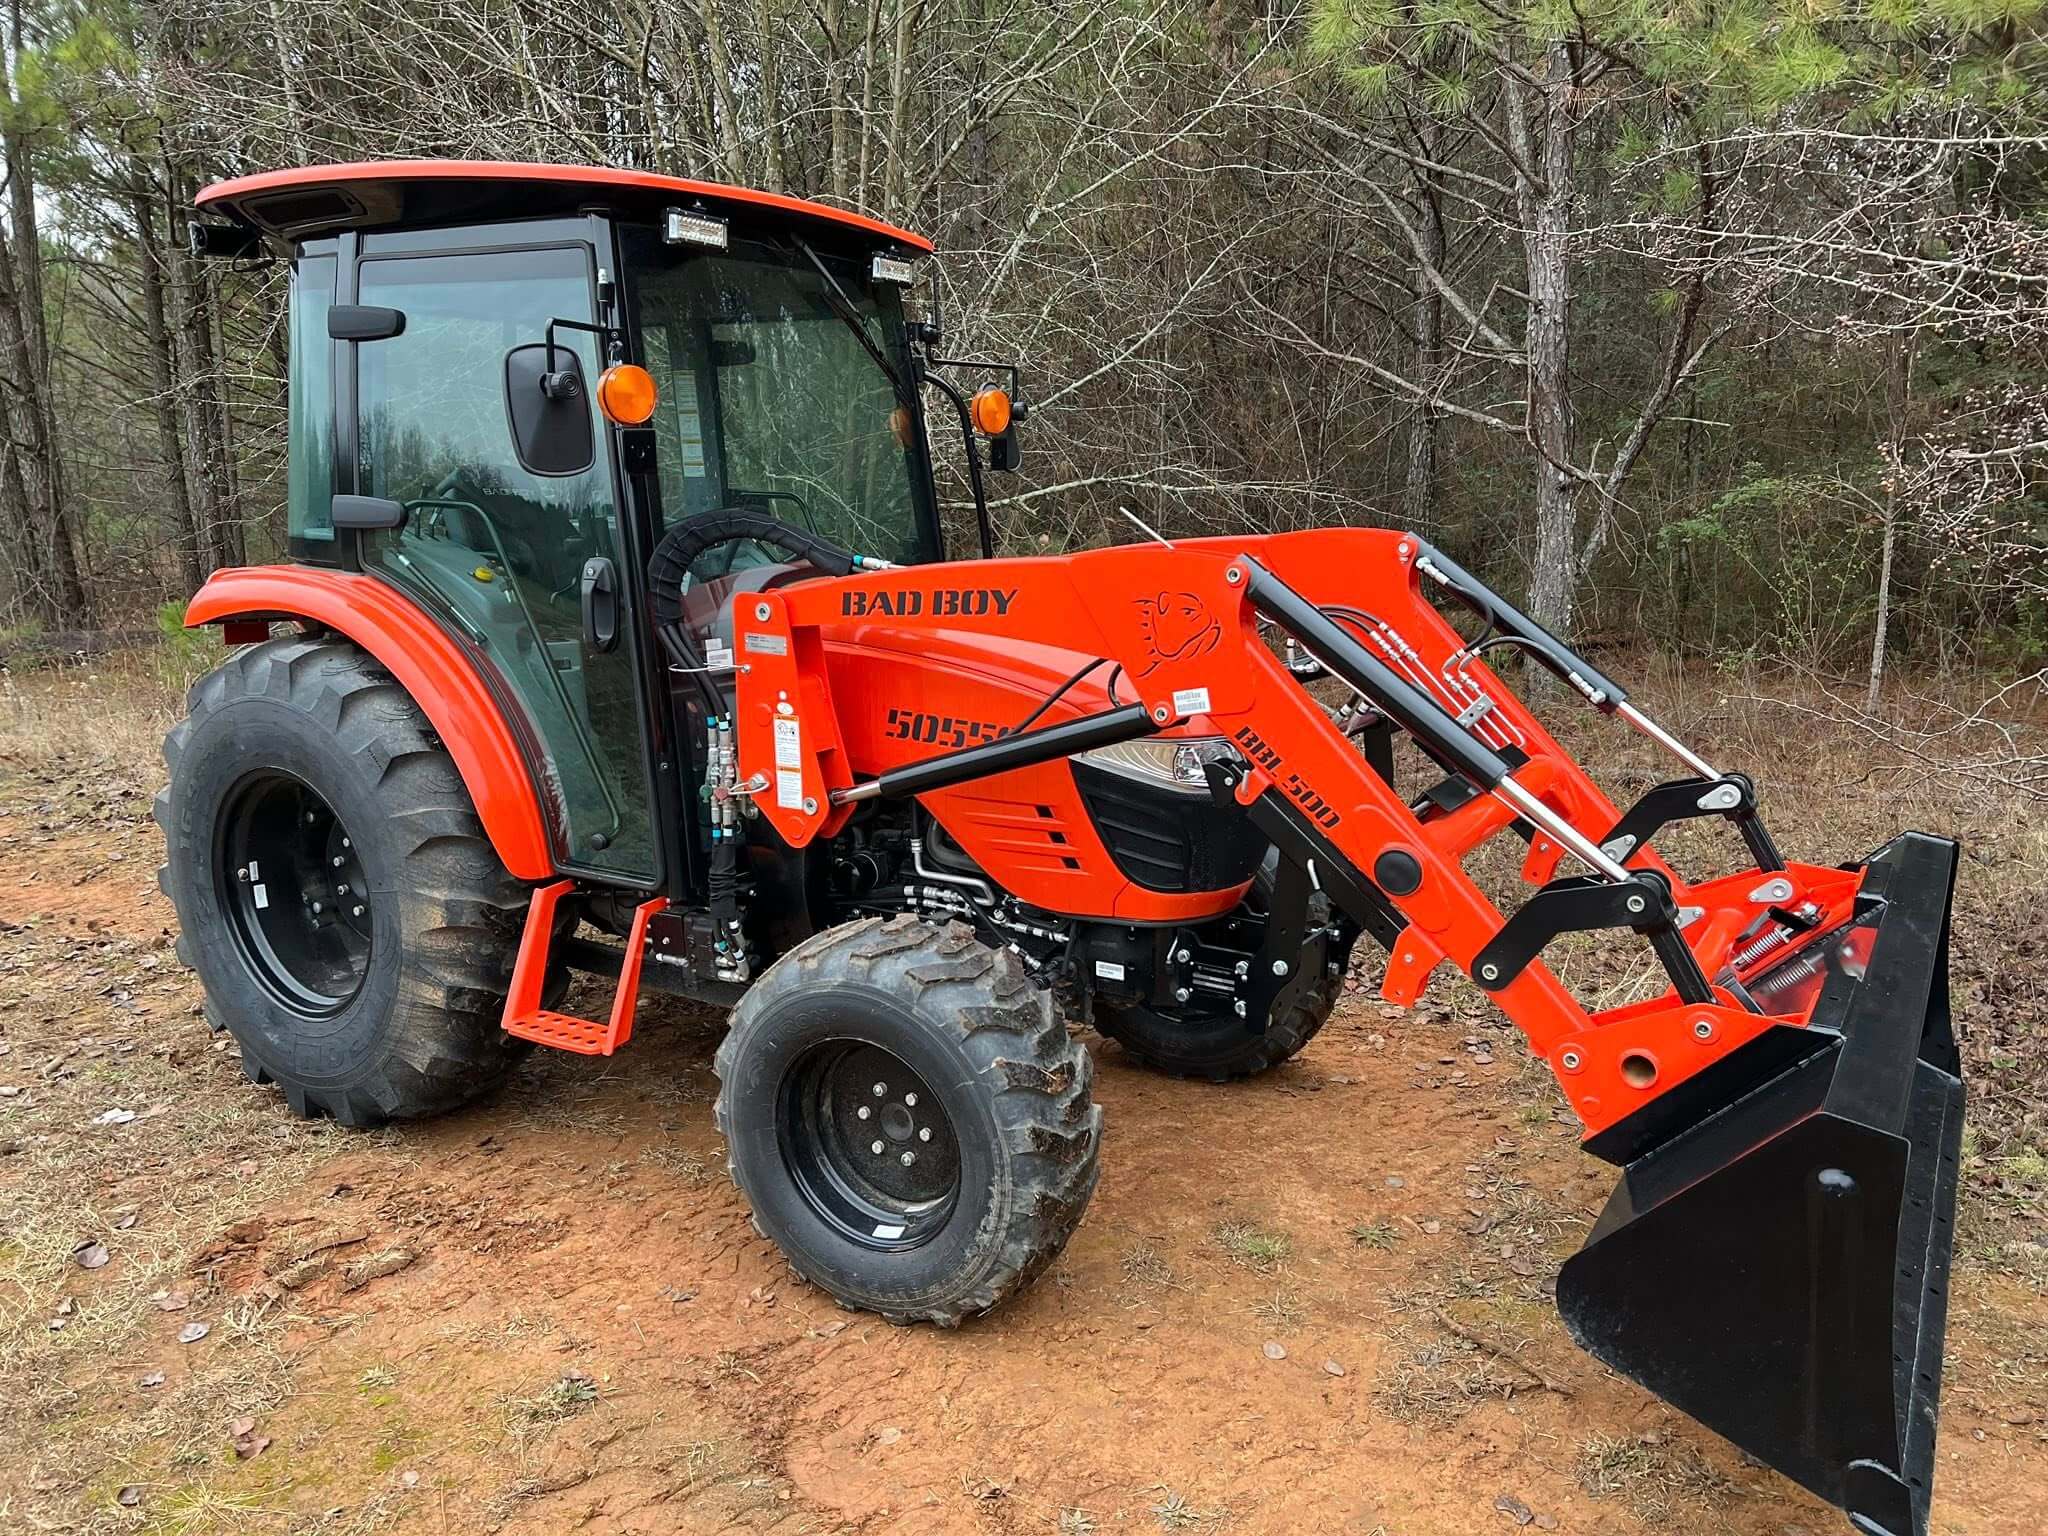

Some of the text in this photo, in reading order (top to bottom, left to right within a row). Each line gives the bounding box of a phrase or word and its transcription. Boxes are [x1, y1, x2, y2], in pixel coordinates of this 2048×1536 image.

[842, 589, 1018, 616] BAD BOY
[1281, 774, 1340, 828] 500
